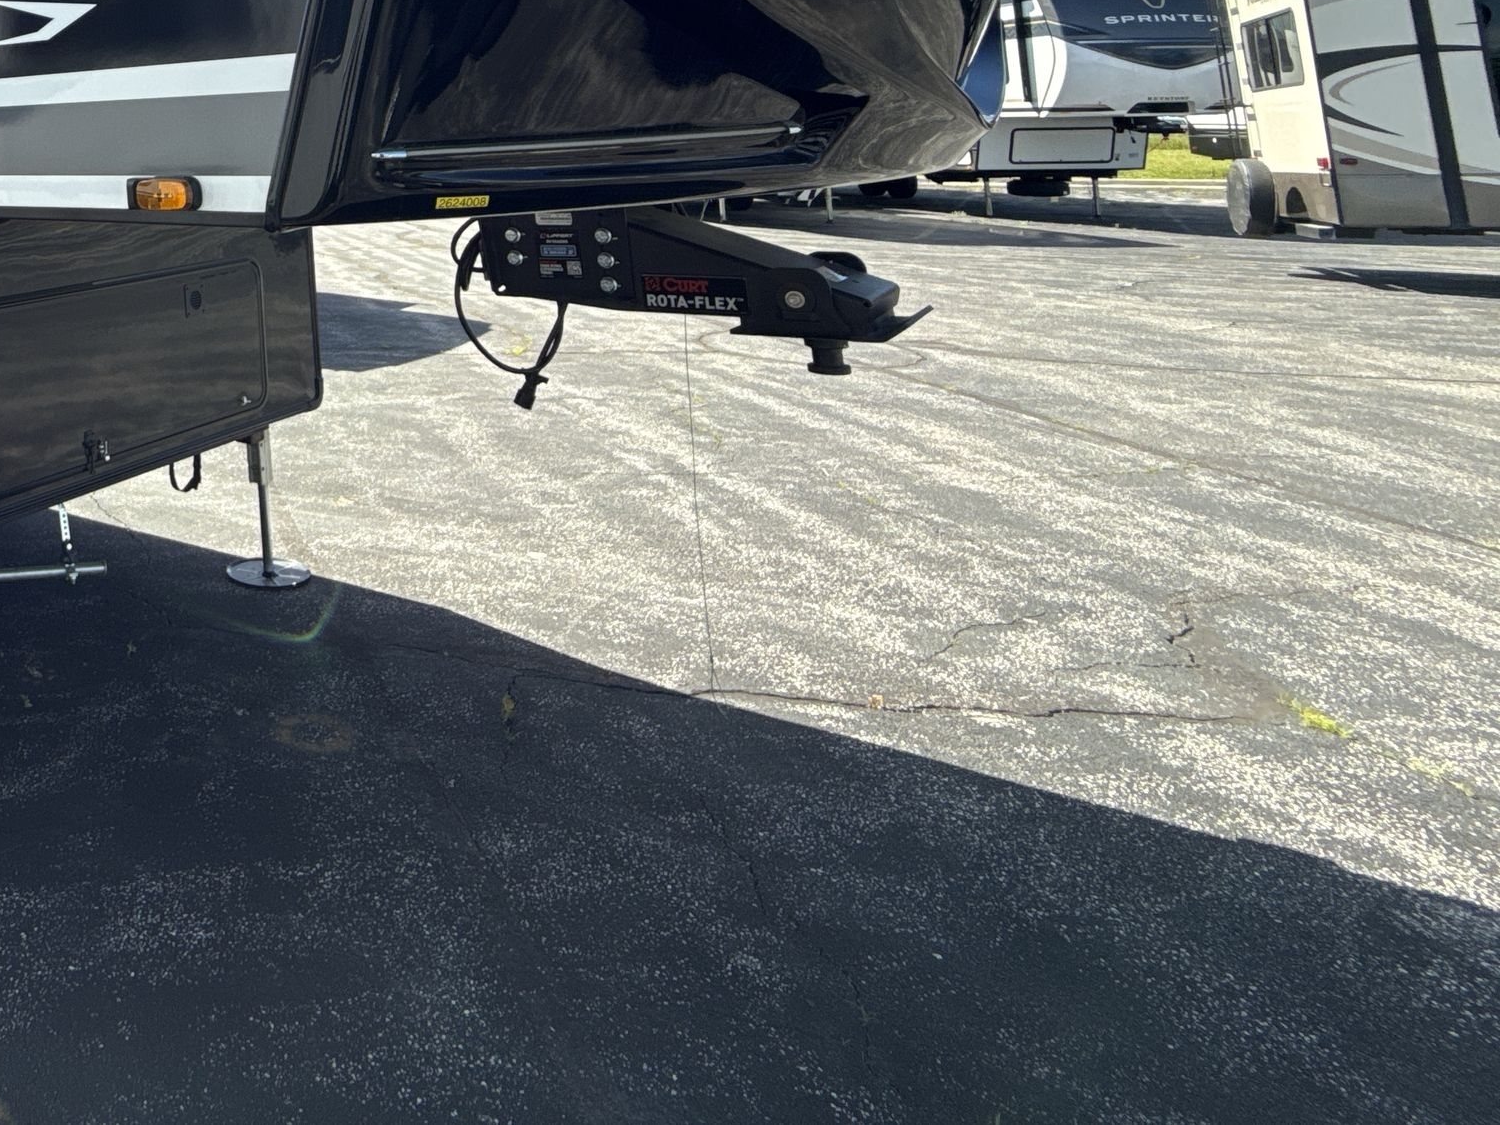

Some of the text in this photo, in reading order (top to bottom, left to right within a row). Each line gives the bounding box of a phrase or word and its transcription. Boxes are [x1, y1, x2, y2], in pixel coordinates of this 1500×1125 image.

[1103, 13, 1219, 25] SPRINTER
[438, 196, 487, 208] 2624008
[645, 293, 739, 311] ROTA-FLEX
